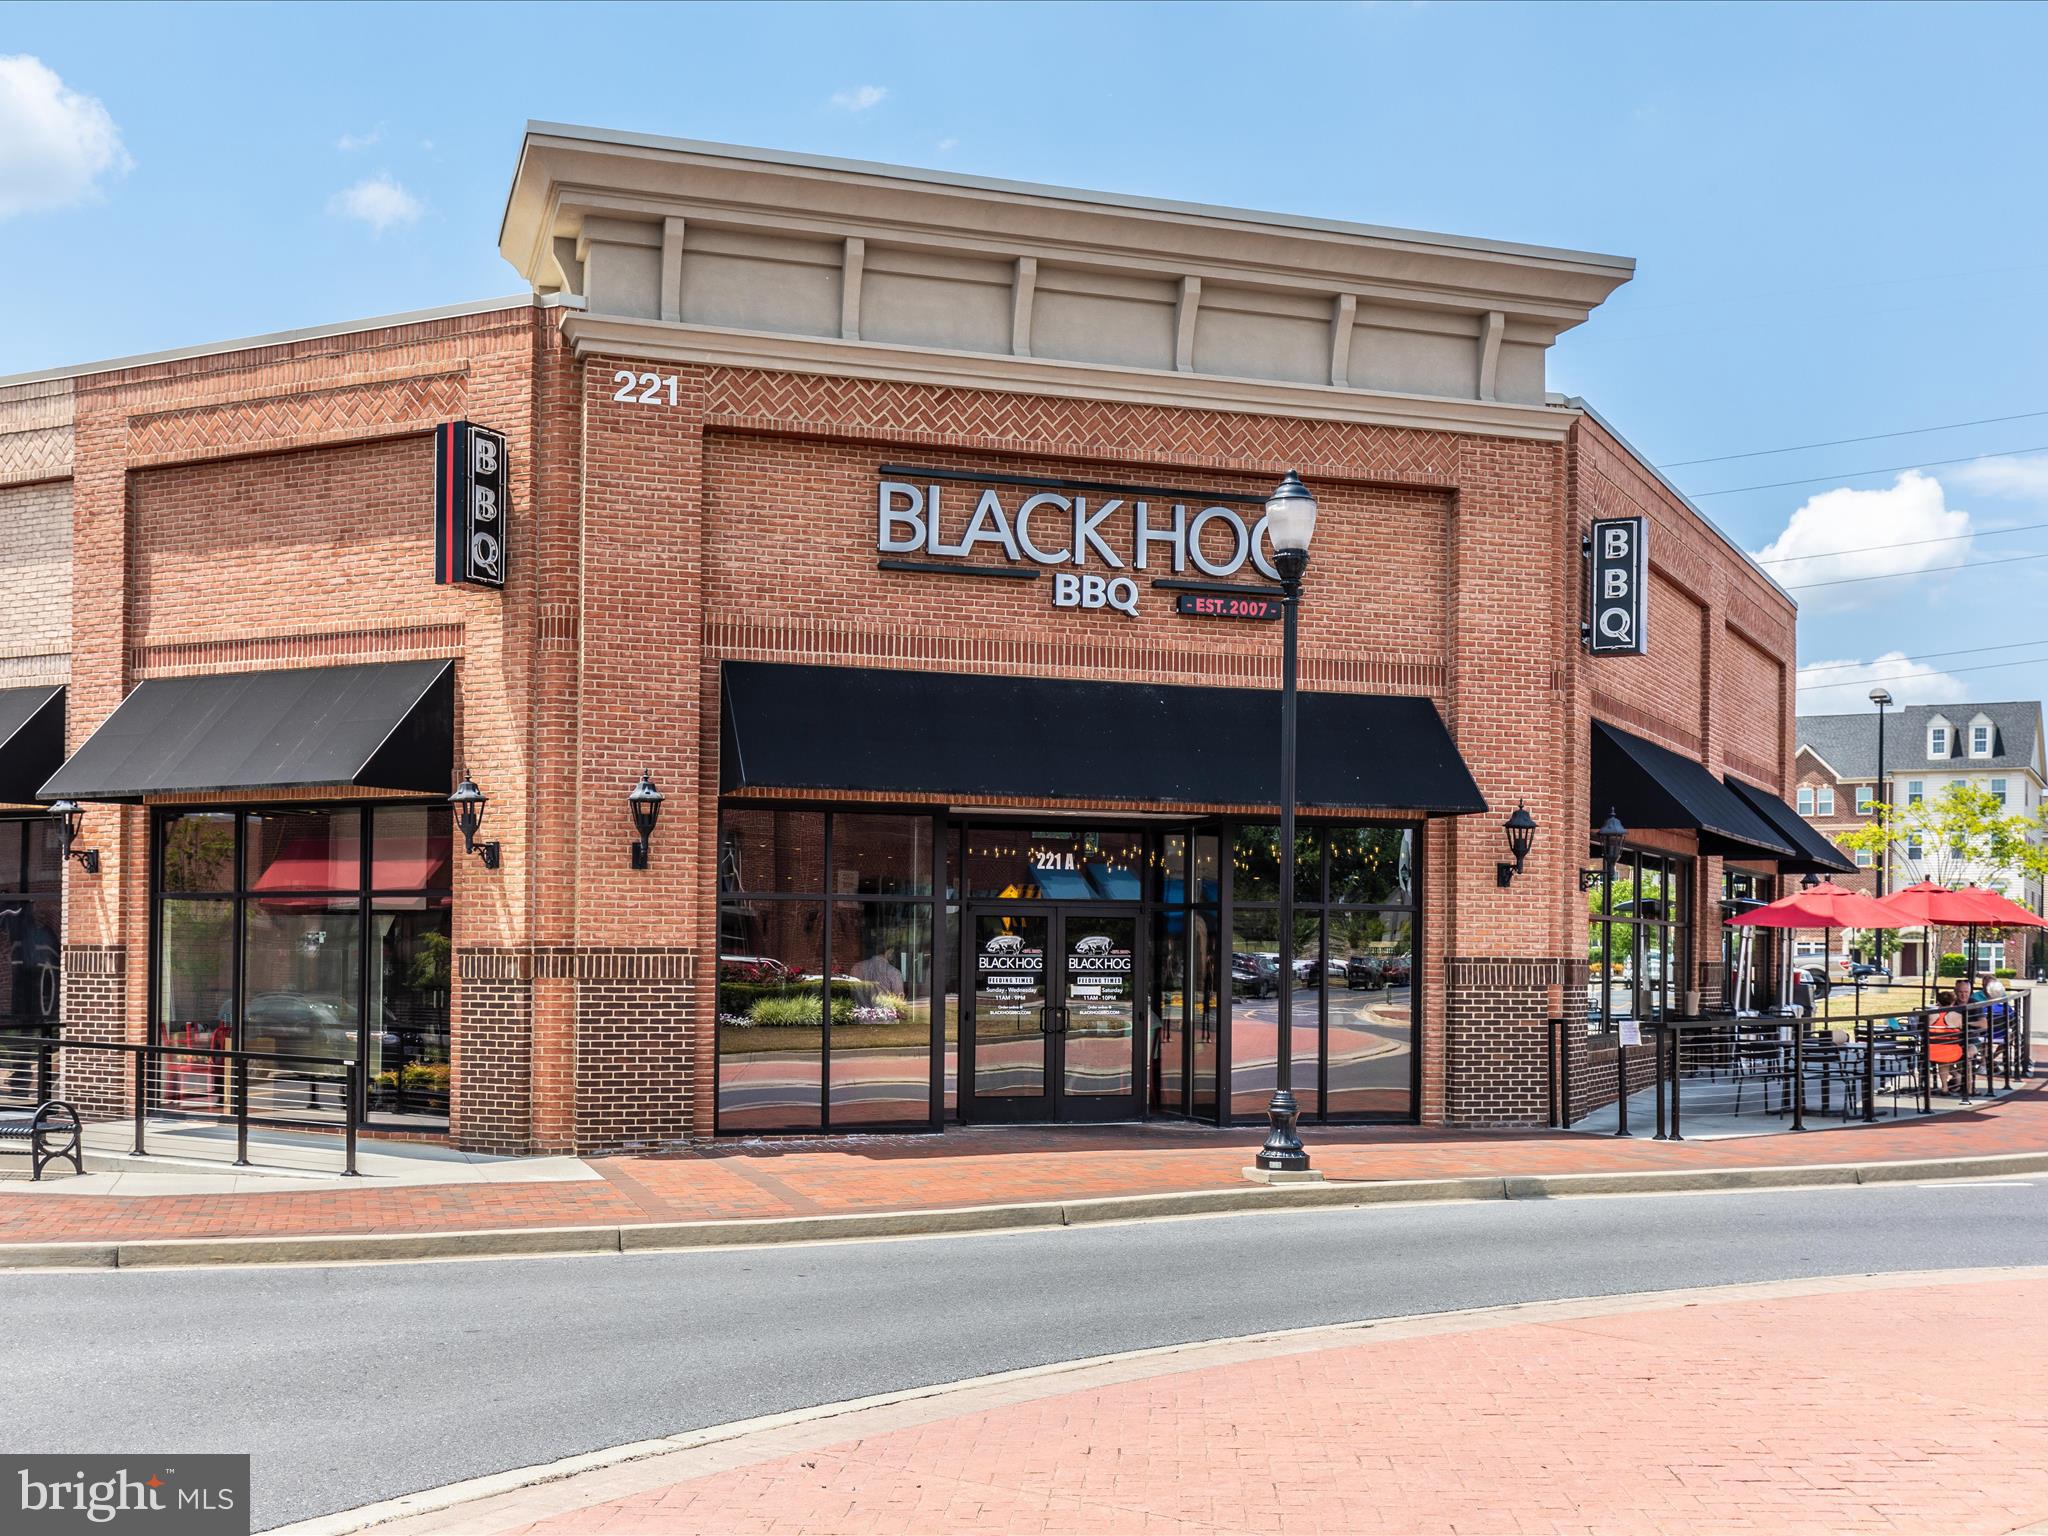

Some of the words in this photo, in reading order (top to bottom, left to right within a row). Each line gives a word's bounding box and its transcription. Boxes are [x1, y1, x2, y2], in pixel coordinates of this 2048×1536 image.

[613, 370, 678, 406] 221
[473, 437, 499, 577] BBQ
[879, 481, 1125, 567] BLACK
[1055, 573, 1140, 617] BBQ
[1599, 528, 1632, 642] BBQ
[1196, 598, 1227, 614] EST.
[1230, 601, 1268, 617] 2007
[1036, 852, 1062, 870] 221
[1065, 853, 1075, 870] A
[979, 957, 1015, 969] BLACK
[1016, 957, 1043, 969] HOG
[1069, 957, 1104, 970] BLACK
[1104, 958, 1131, 970] HOG
[1008, 987, 1038, 995] Wednesday
